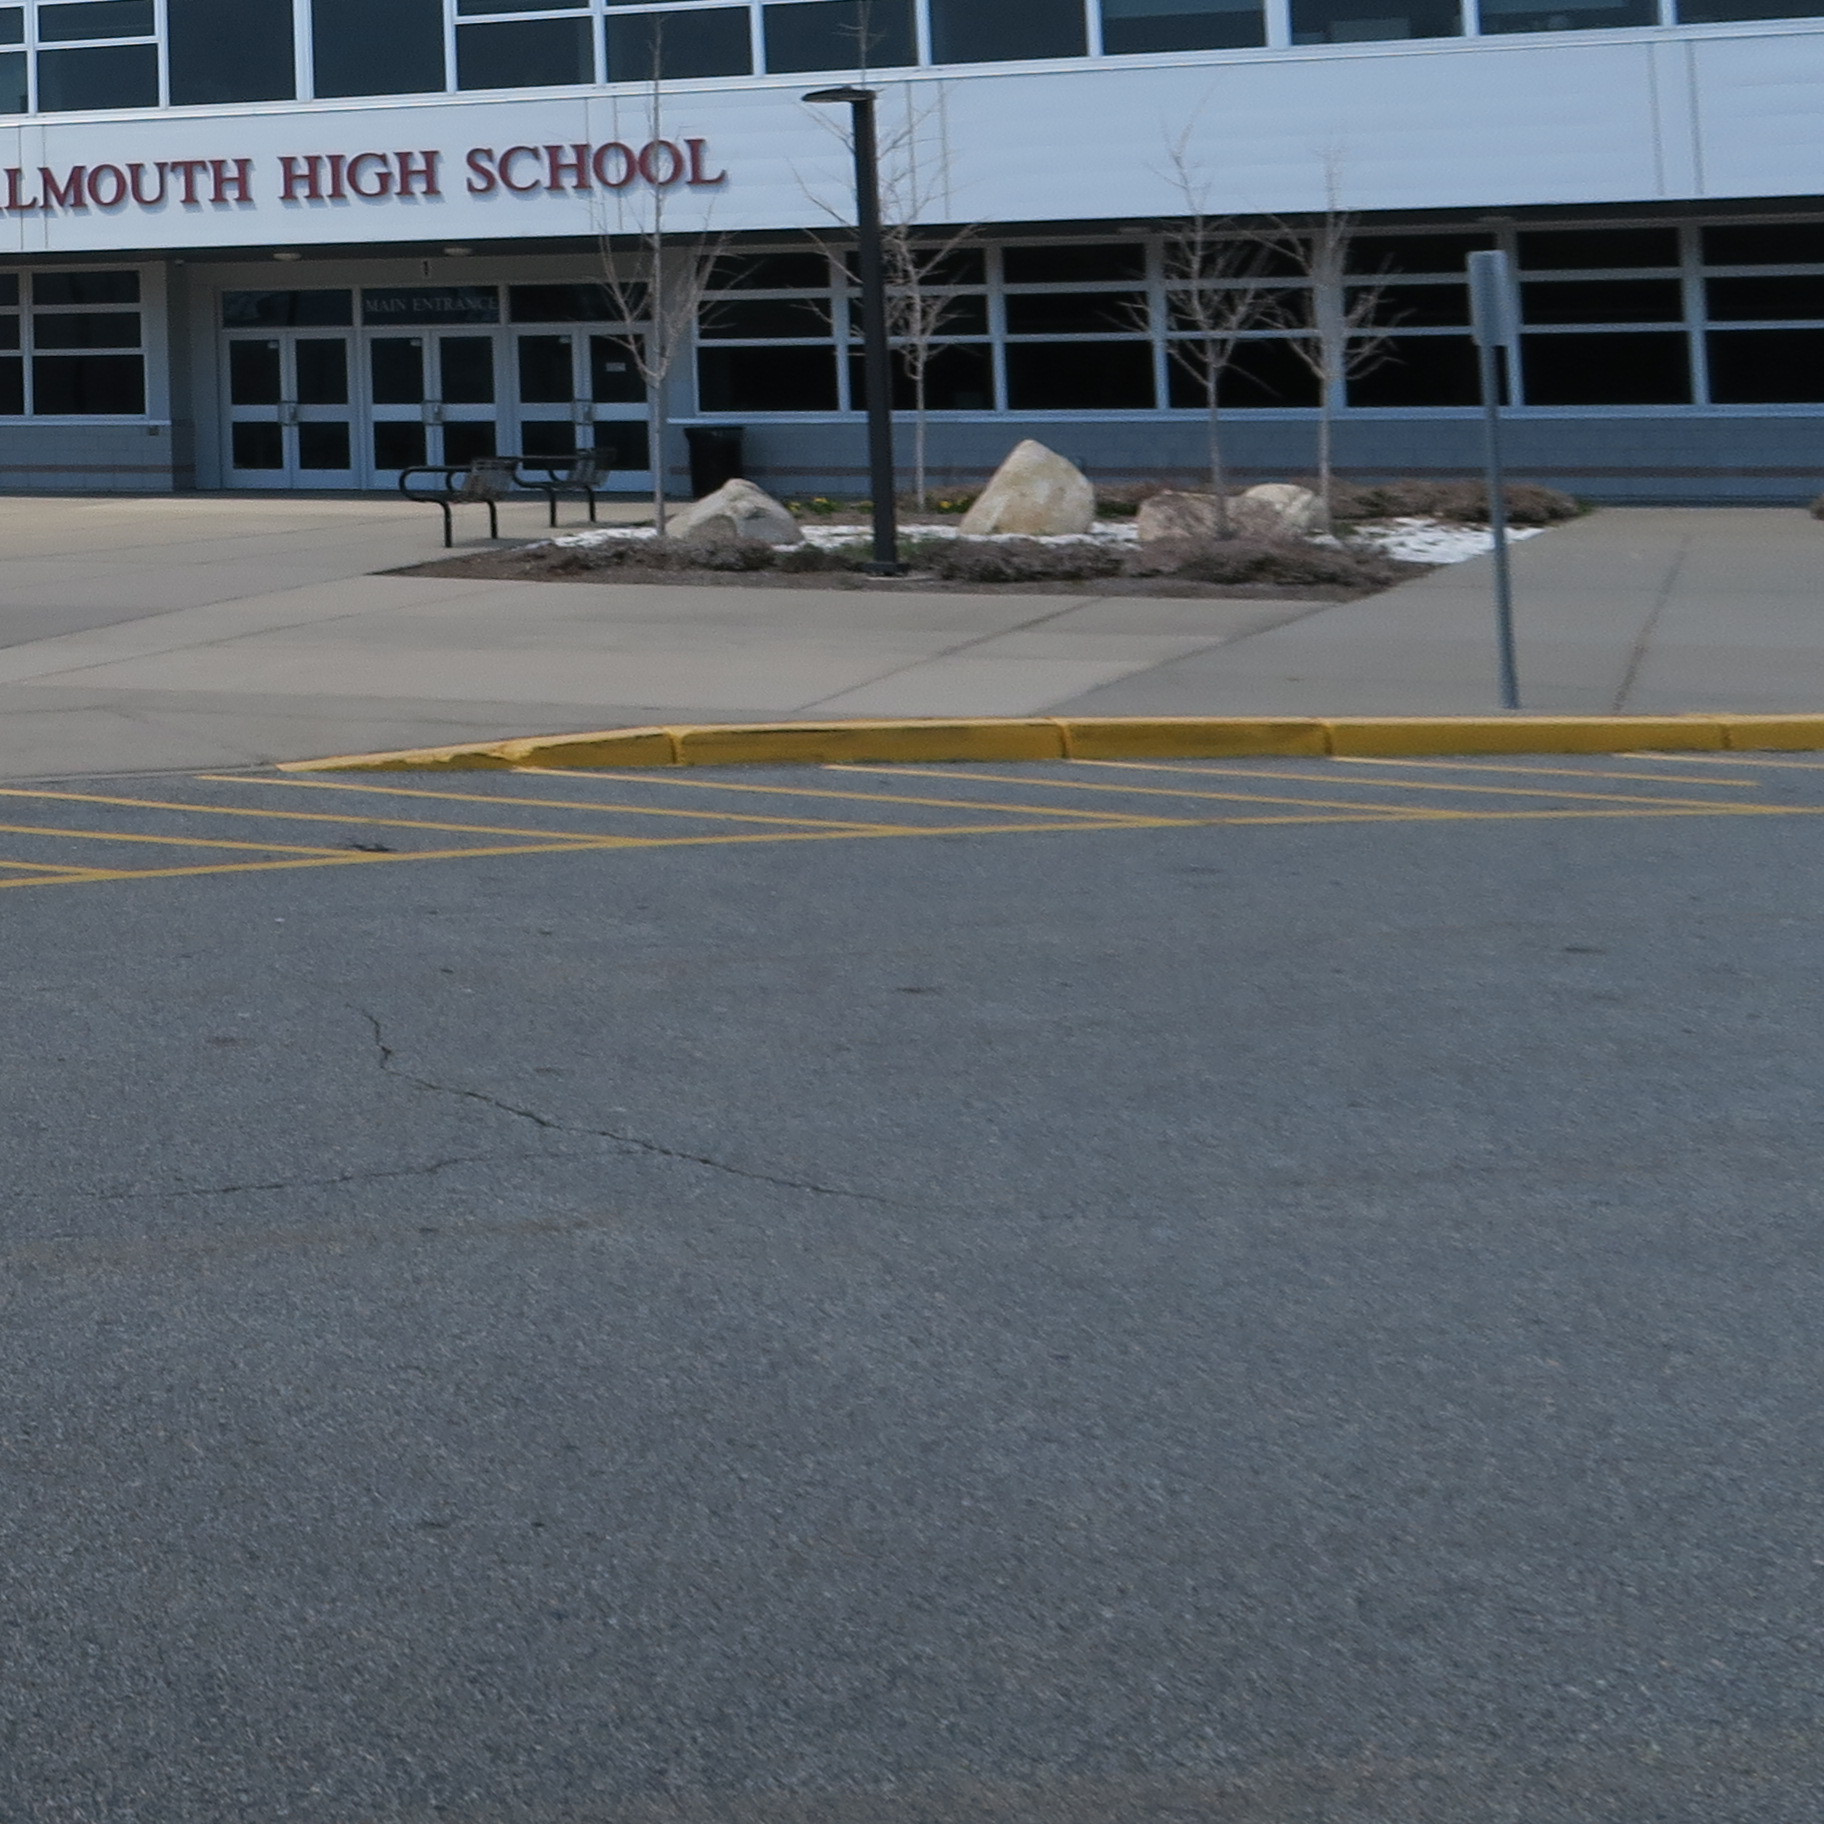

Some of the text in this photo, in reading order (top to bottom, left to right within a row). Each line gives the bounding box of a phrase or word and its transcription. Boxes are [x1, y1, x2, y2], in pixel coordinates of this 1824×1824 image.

[277, 149, 442, 201] HIGH
[465, 137, 728, 194] SCHOOL
[365, 296, 500, 312] MAIN ENTRANCE
